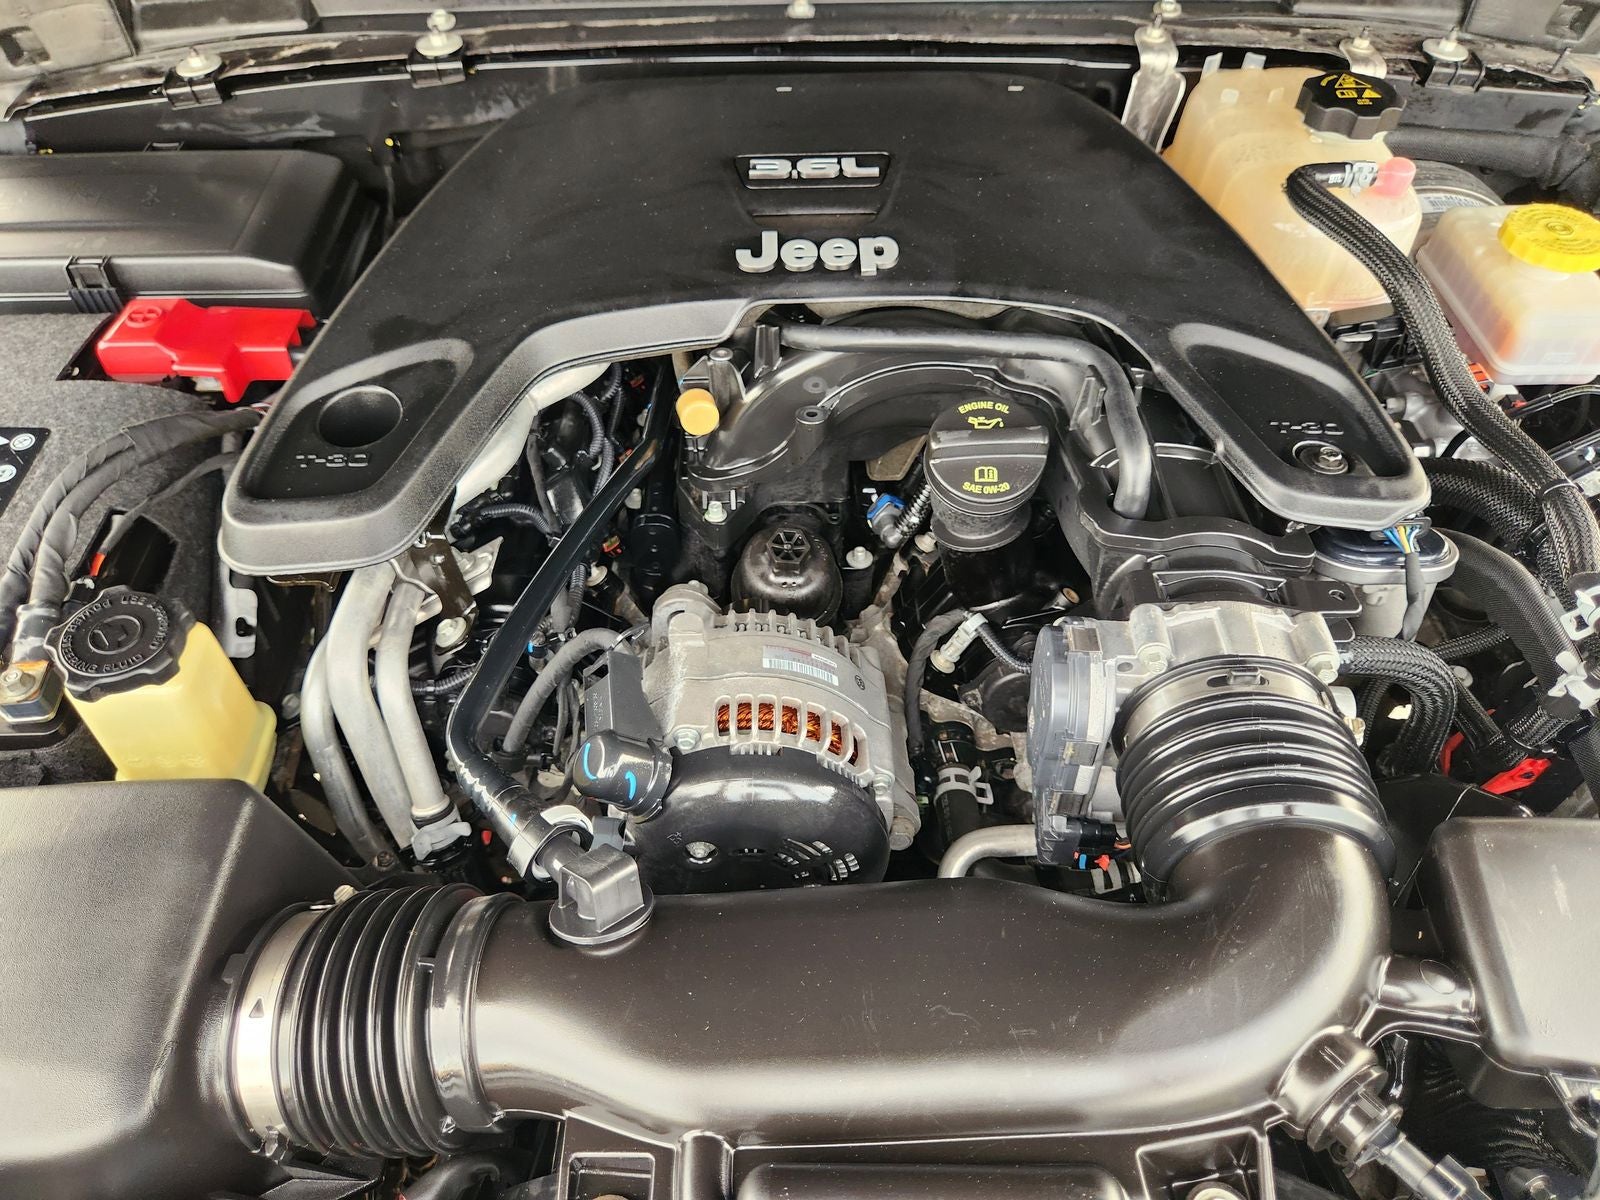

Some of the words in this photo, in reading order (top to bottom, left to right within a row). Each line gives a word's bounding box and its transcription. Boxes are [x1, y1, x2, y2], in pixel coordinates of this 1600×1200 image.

[748, 157, 880, 180] 3.6L
[735, 230, 900, 276] Jeep
[958, 401, 995, 414] ENGINE
[994, 403, 1010, 414] OIL
[962, 481, 983, 494] SAE
[982, 481, 1011, 495] 0W-20
[120, 595, 148, 606] USE
[67, 599, 113, 634] POWER
[60, 634, 99, 674] STEERING
[102, 653, 144, 674] FLUID
